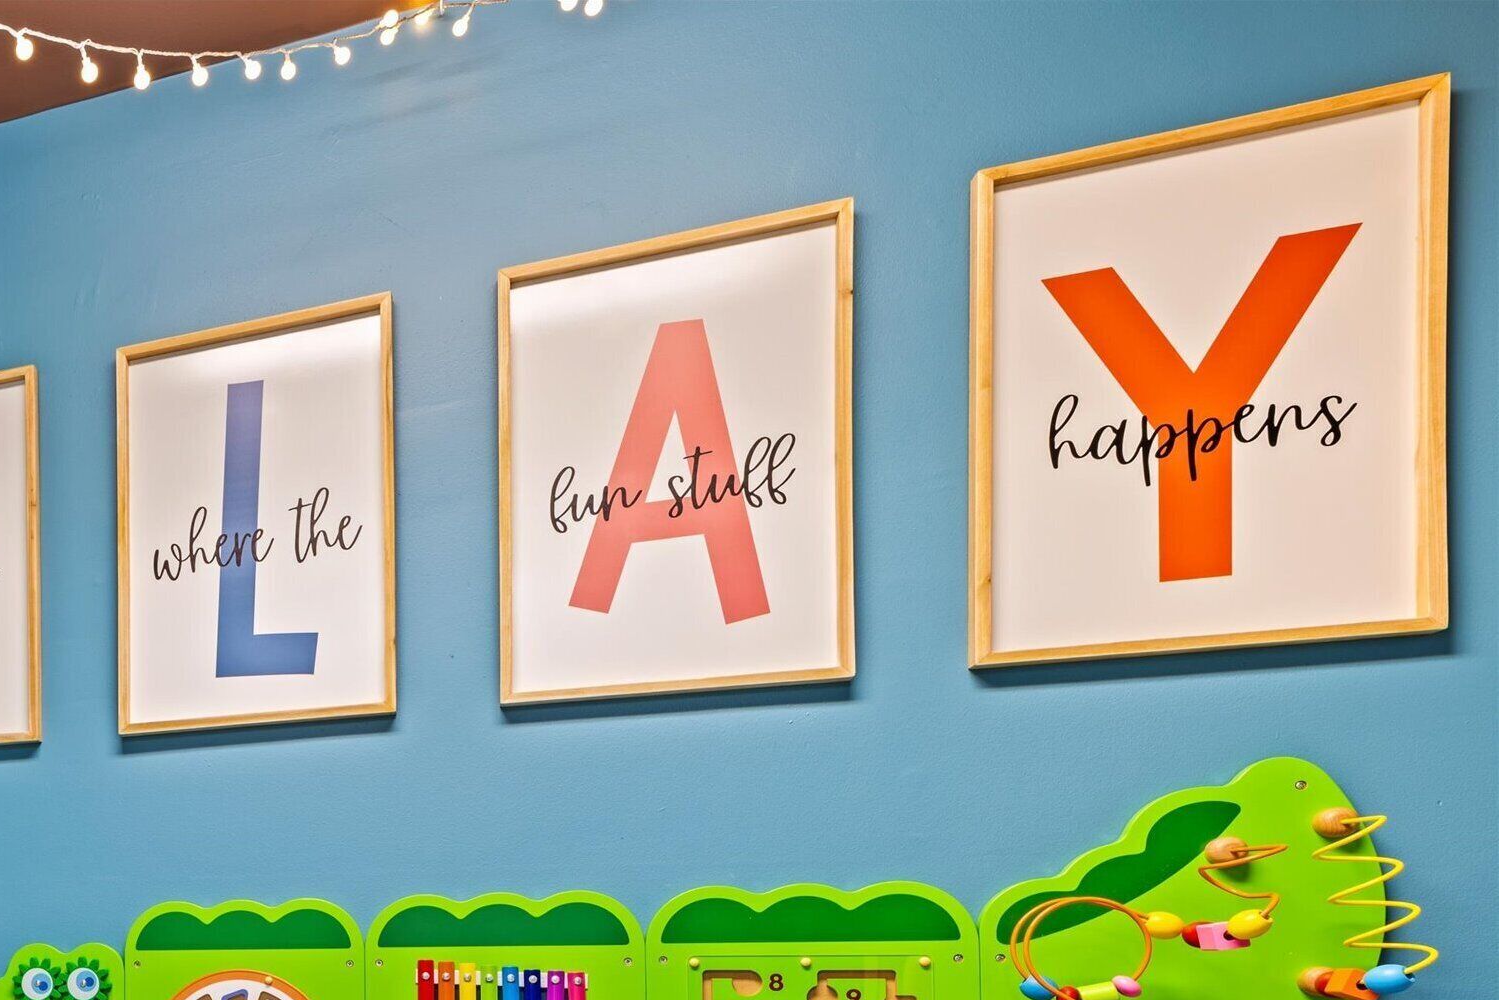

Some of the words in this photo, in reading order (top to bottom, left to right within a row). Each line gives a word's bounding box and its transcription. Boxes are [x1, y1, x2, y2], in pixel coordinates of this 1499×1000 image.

[1040, 221, 1364, 583] Y
[1048, 393, 1359, 487] happens
[549, 465, 643, 535] fun
[667, 432, 797, 519] stuff
[567, 317, 772, 626] A
[152, 505, 275, 582] where
[287, 486, 363, 564] the
[215, 379, 320, 678] L
[768, 973, 784, 992] 8
